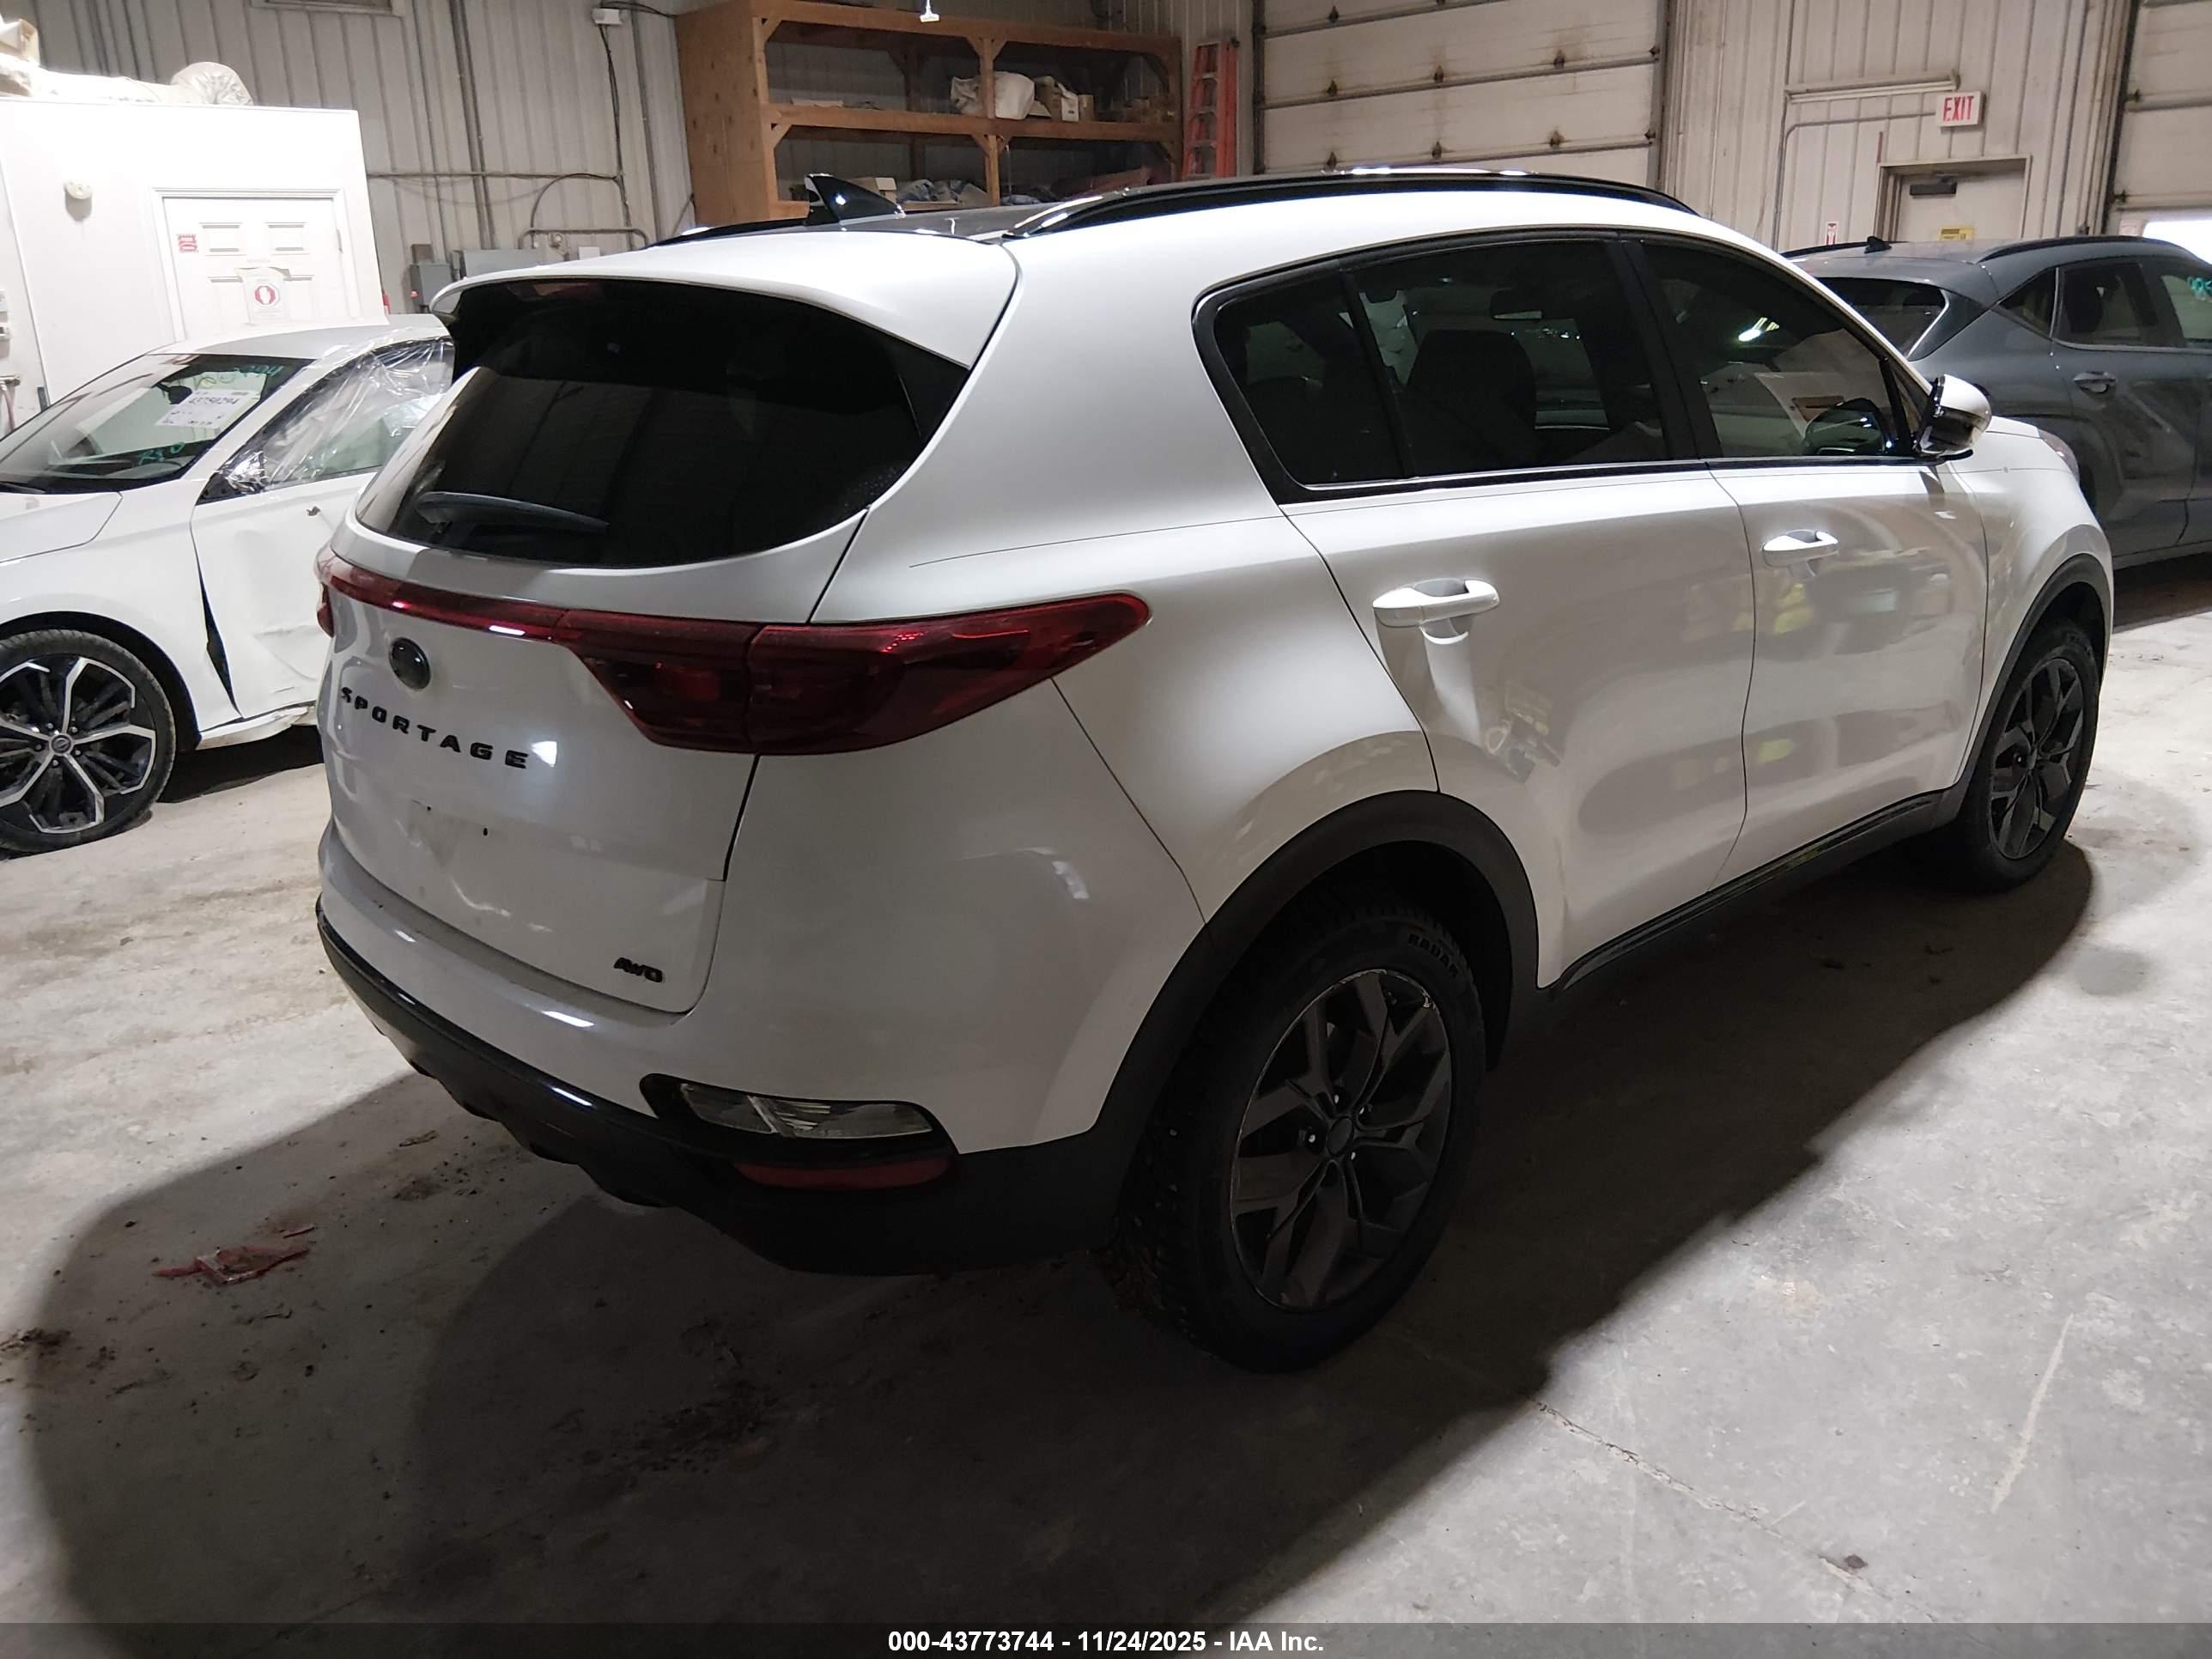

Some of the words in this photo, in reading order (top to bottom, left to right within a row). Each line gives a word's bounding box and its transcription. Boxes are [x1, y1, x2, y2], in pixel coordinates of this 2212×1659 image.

[1943, 95, 1974, 121] EXIT
[342, 687, 529, 769] SPORTAGE
[613, 957, 663, 983] AWD
[1407, 933, 1458, 978] RADAR
